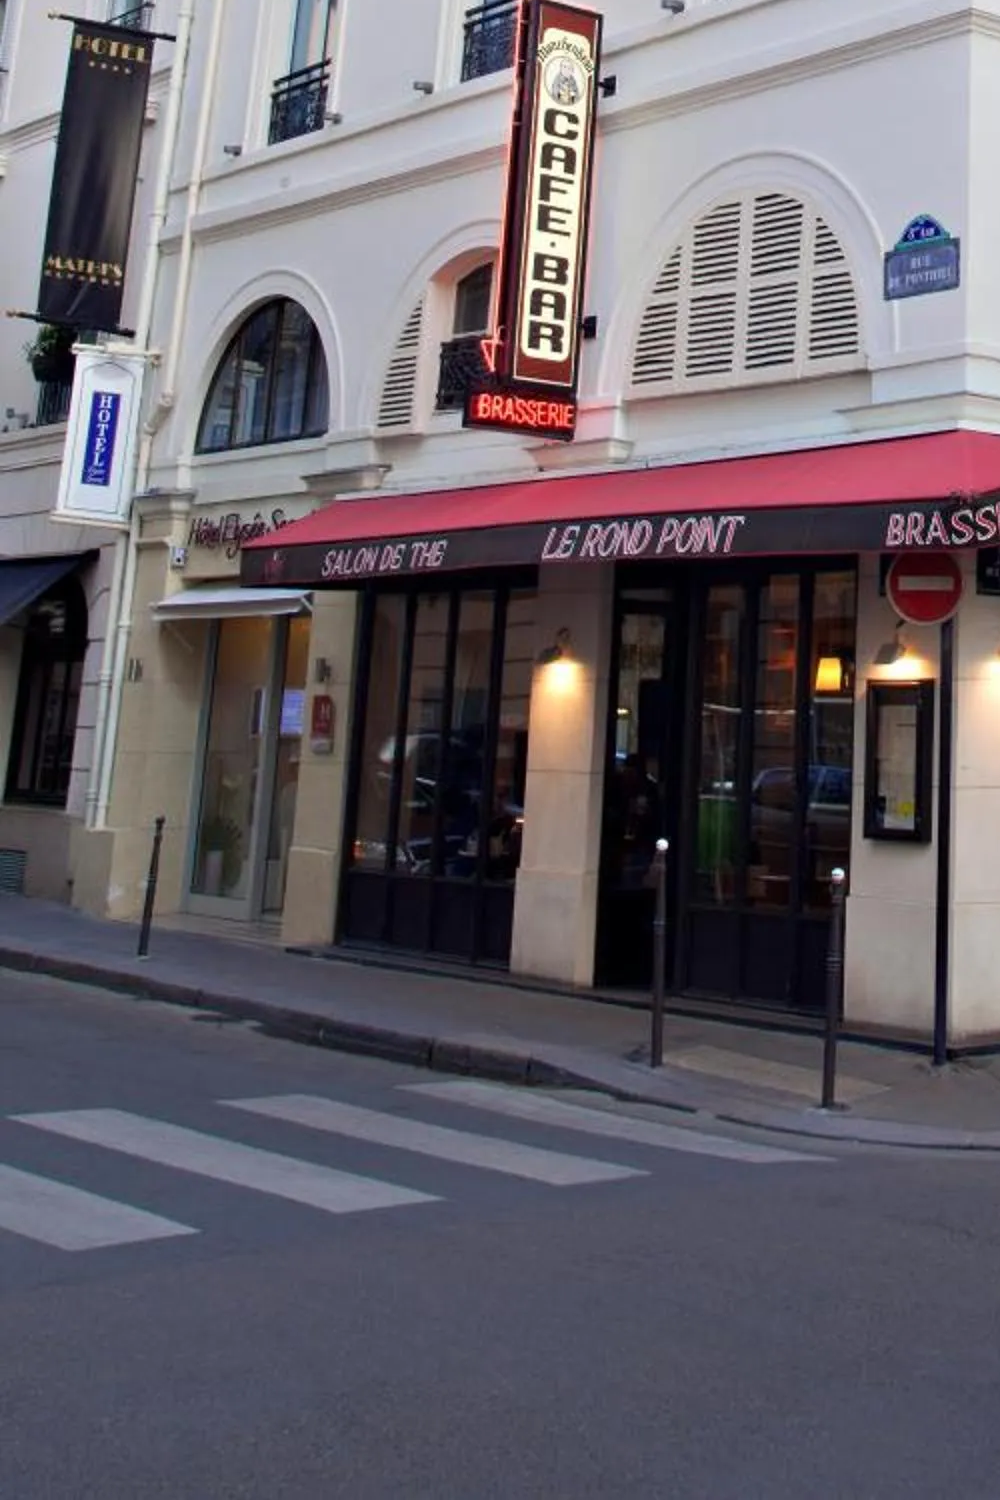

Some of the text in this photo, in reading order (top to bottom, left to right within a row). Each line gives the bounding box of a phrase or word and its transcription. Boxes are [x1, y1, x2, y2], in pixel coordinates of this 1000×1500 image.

[75, 34, 150, 63] HOTEL
[527, 252, 569, 354] BAR
[477, 393, 575, 428] BRASSERIE
[94, 394, 113, 468] HOTEL
[541, 515, 745, 560] LE ROND POINT
[321, 547, 380, 577] SALON
[379, 544, 405, 571] DE
